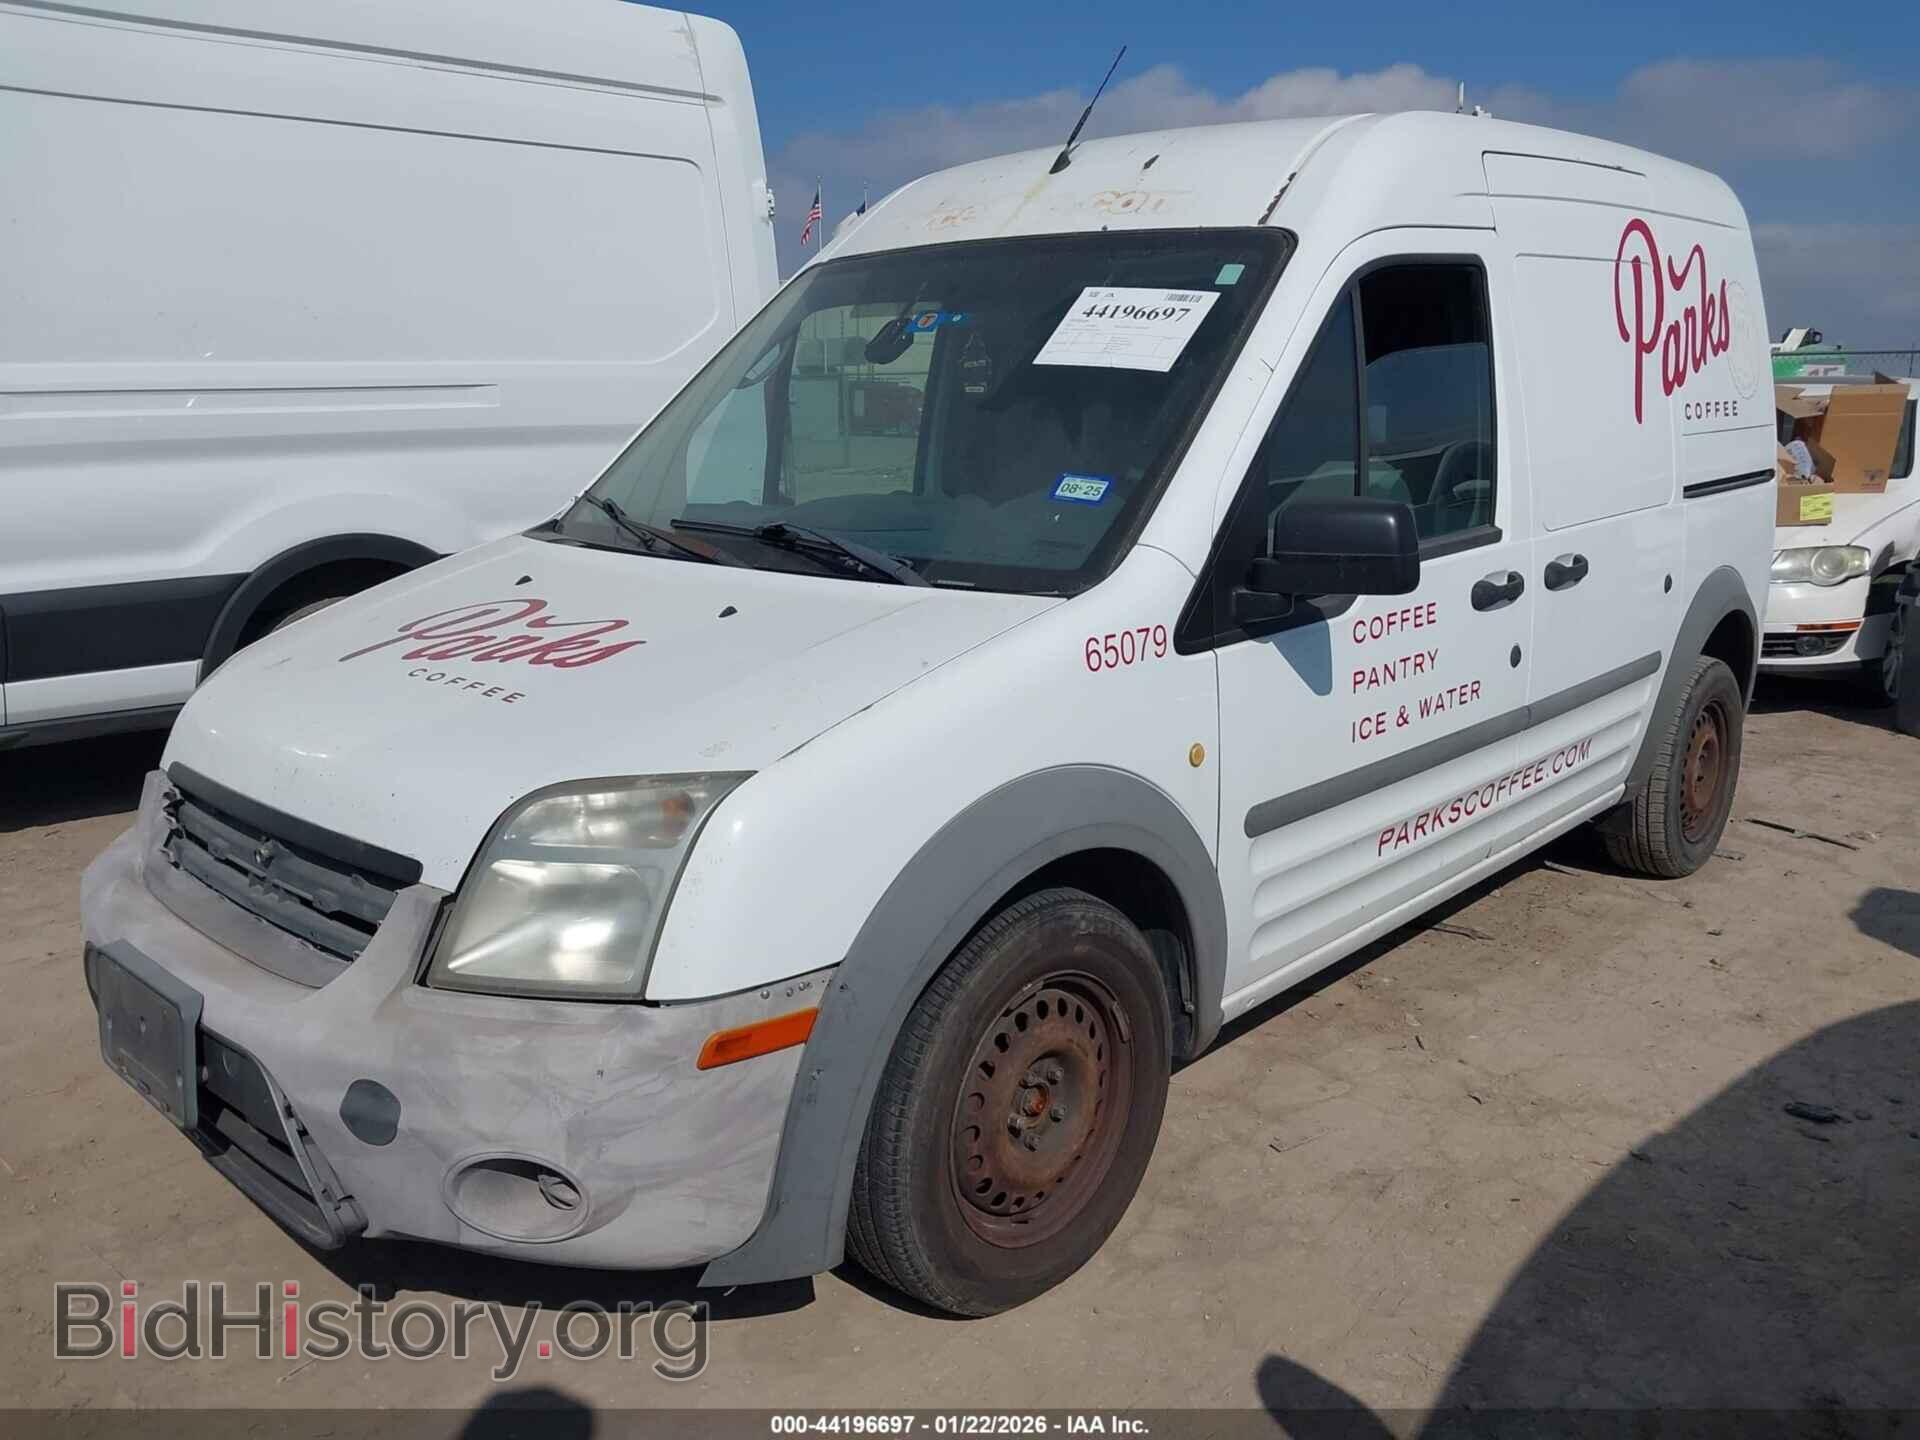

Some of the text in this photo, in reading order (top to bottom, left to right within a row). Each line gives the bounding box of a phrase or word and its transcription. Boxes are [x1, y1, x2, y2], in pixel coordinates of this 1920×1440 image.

[1081, 303, 1191, 323] 44196697
[1614, 218, 1730, 425] Parks
[1684, 400, 1738, 420] COFFEE
[338, 598, 647, 668] Parks
[1352, 602, 1437, 644] COFFEE
[1085, 624, 1167, 672] 65079
[407, 667, 526, 704] COFFEE
[1352, 649, 1439, 694] PANTRY
[1351, 680, 1481, 743] ICE & WATER
[1377, 738, 1593, 857] PARKSCOFFEE.COM
